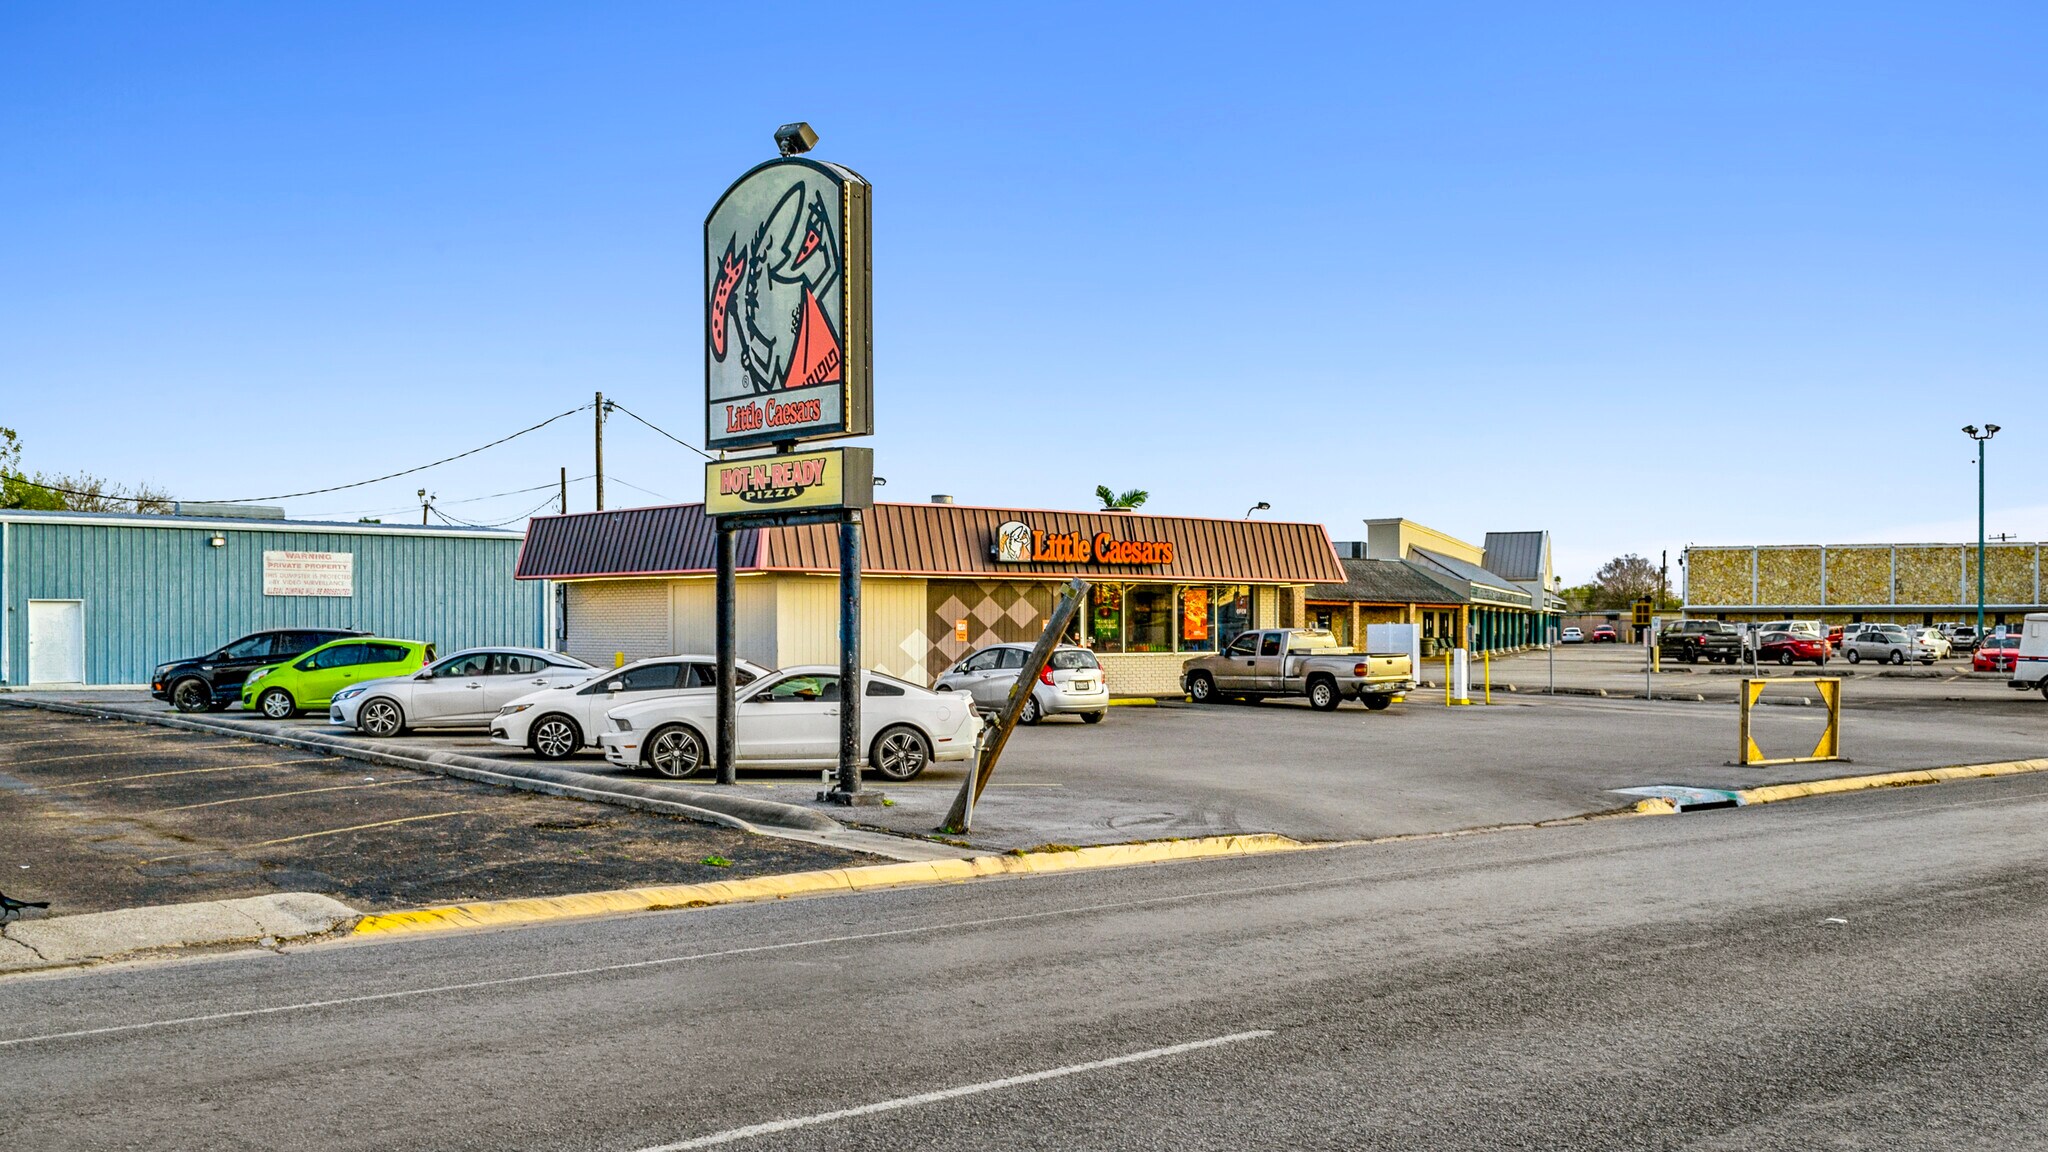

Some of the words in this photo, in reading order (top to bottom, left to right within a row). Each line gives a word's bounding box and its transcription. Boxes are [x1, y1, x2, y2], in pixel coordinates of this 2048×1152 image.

[726, 401, 763, 433] Little
[765, 398, 821, 427] Caesars
[721, 458, 826, 495] HOT-N-READY
[746, 488, 798, 500] PIZZA
[1032, 529, 1091, 563] Little
[1094, 531, 1174, 565] Caesars
